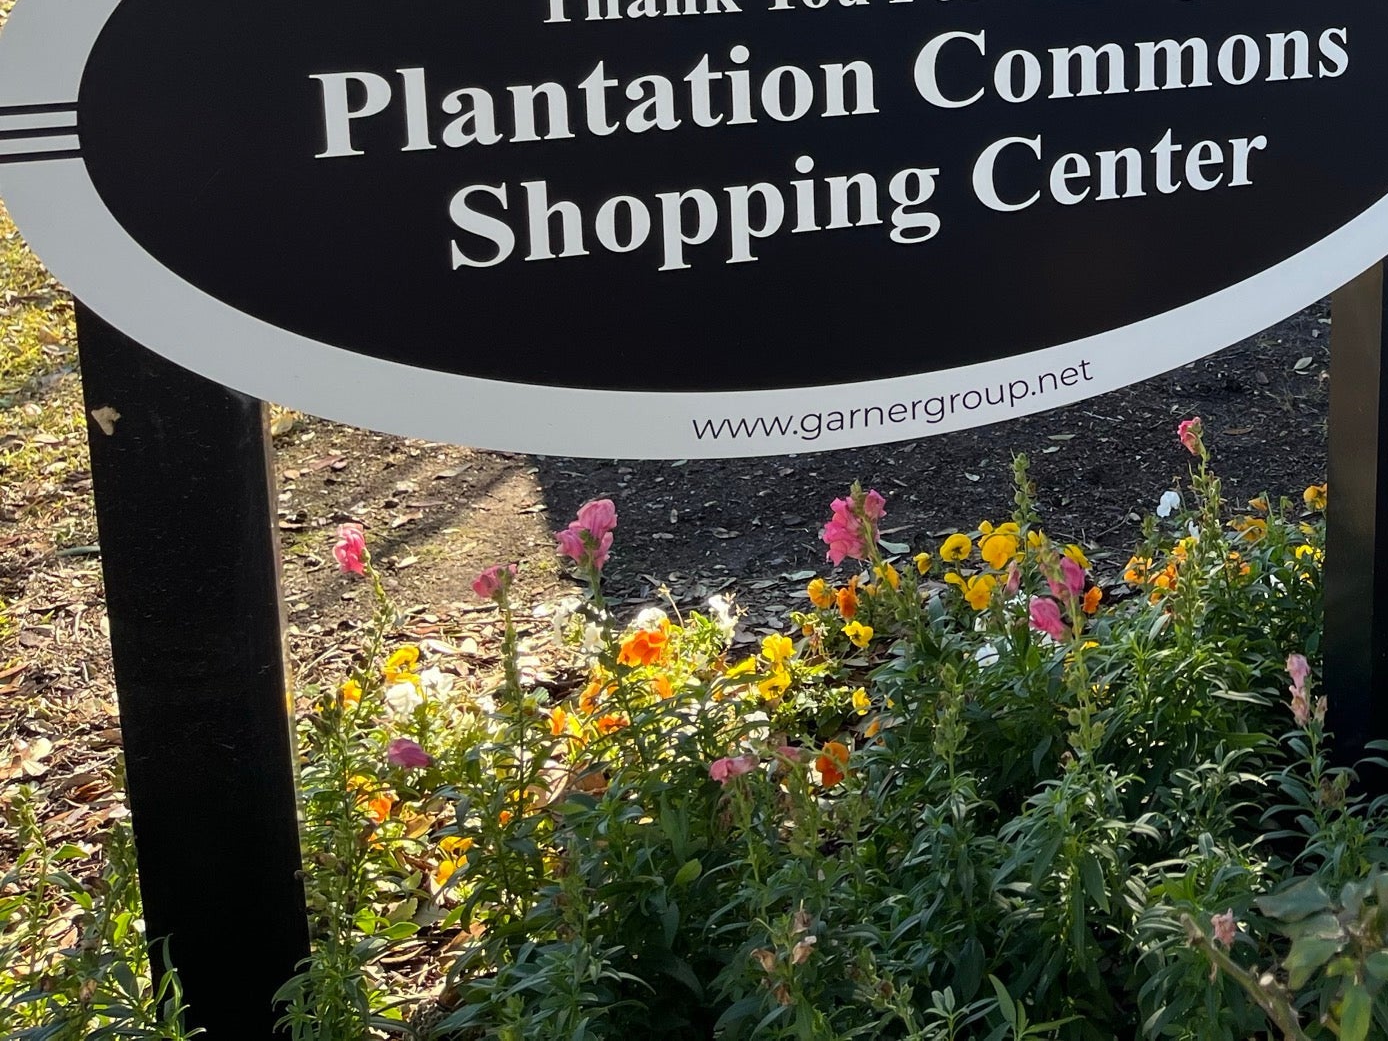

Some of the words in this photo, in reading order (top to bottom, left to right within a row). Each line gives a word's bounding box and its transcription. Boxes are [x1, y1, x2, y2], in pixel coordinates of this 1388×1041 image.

[309, 44, 880, 159] Plantation
[913, 21, 1350, 109] Commons
[448, 155, 941, 272] Shopping
[972, 127, 1270, 213] Center
[692, 358, 1094, 441] www.garnergroup.net
